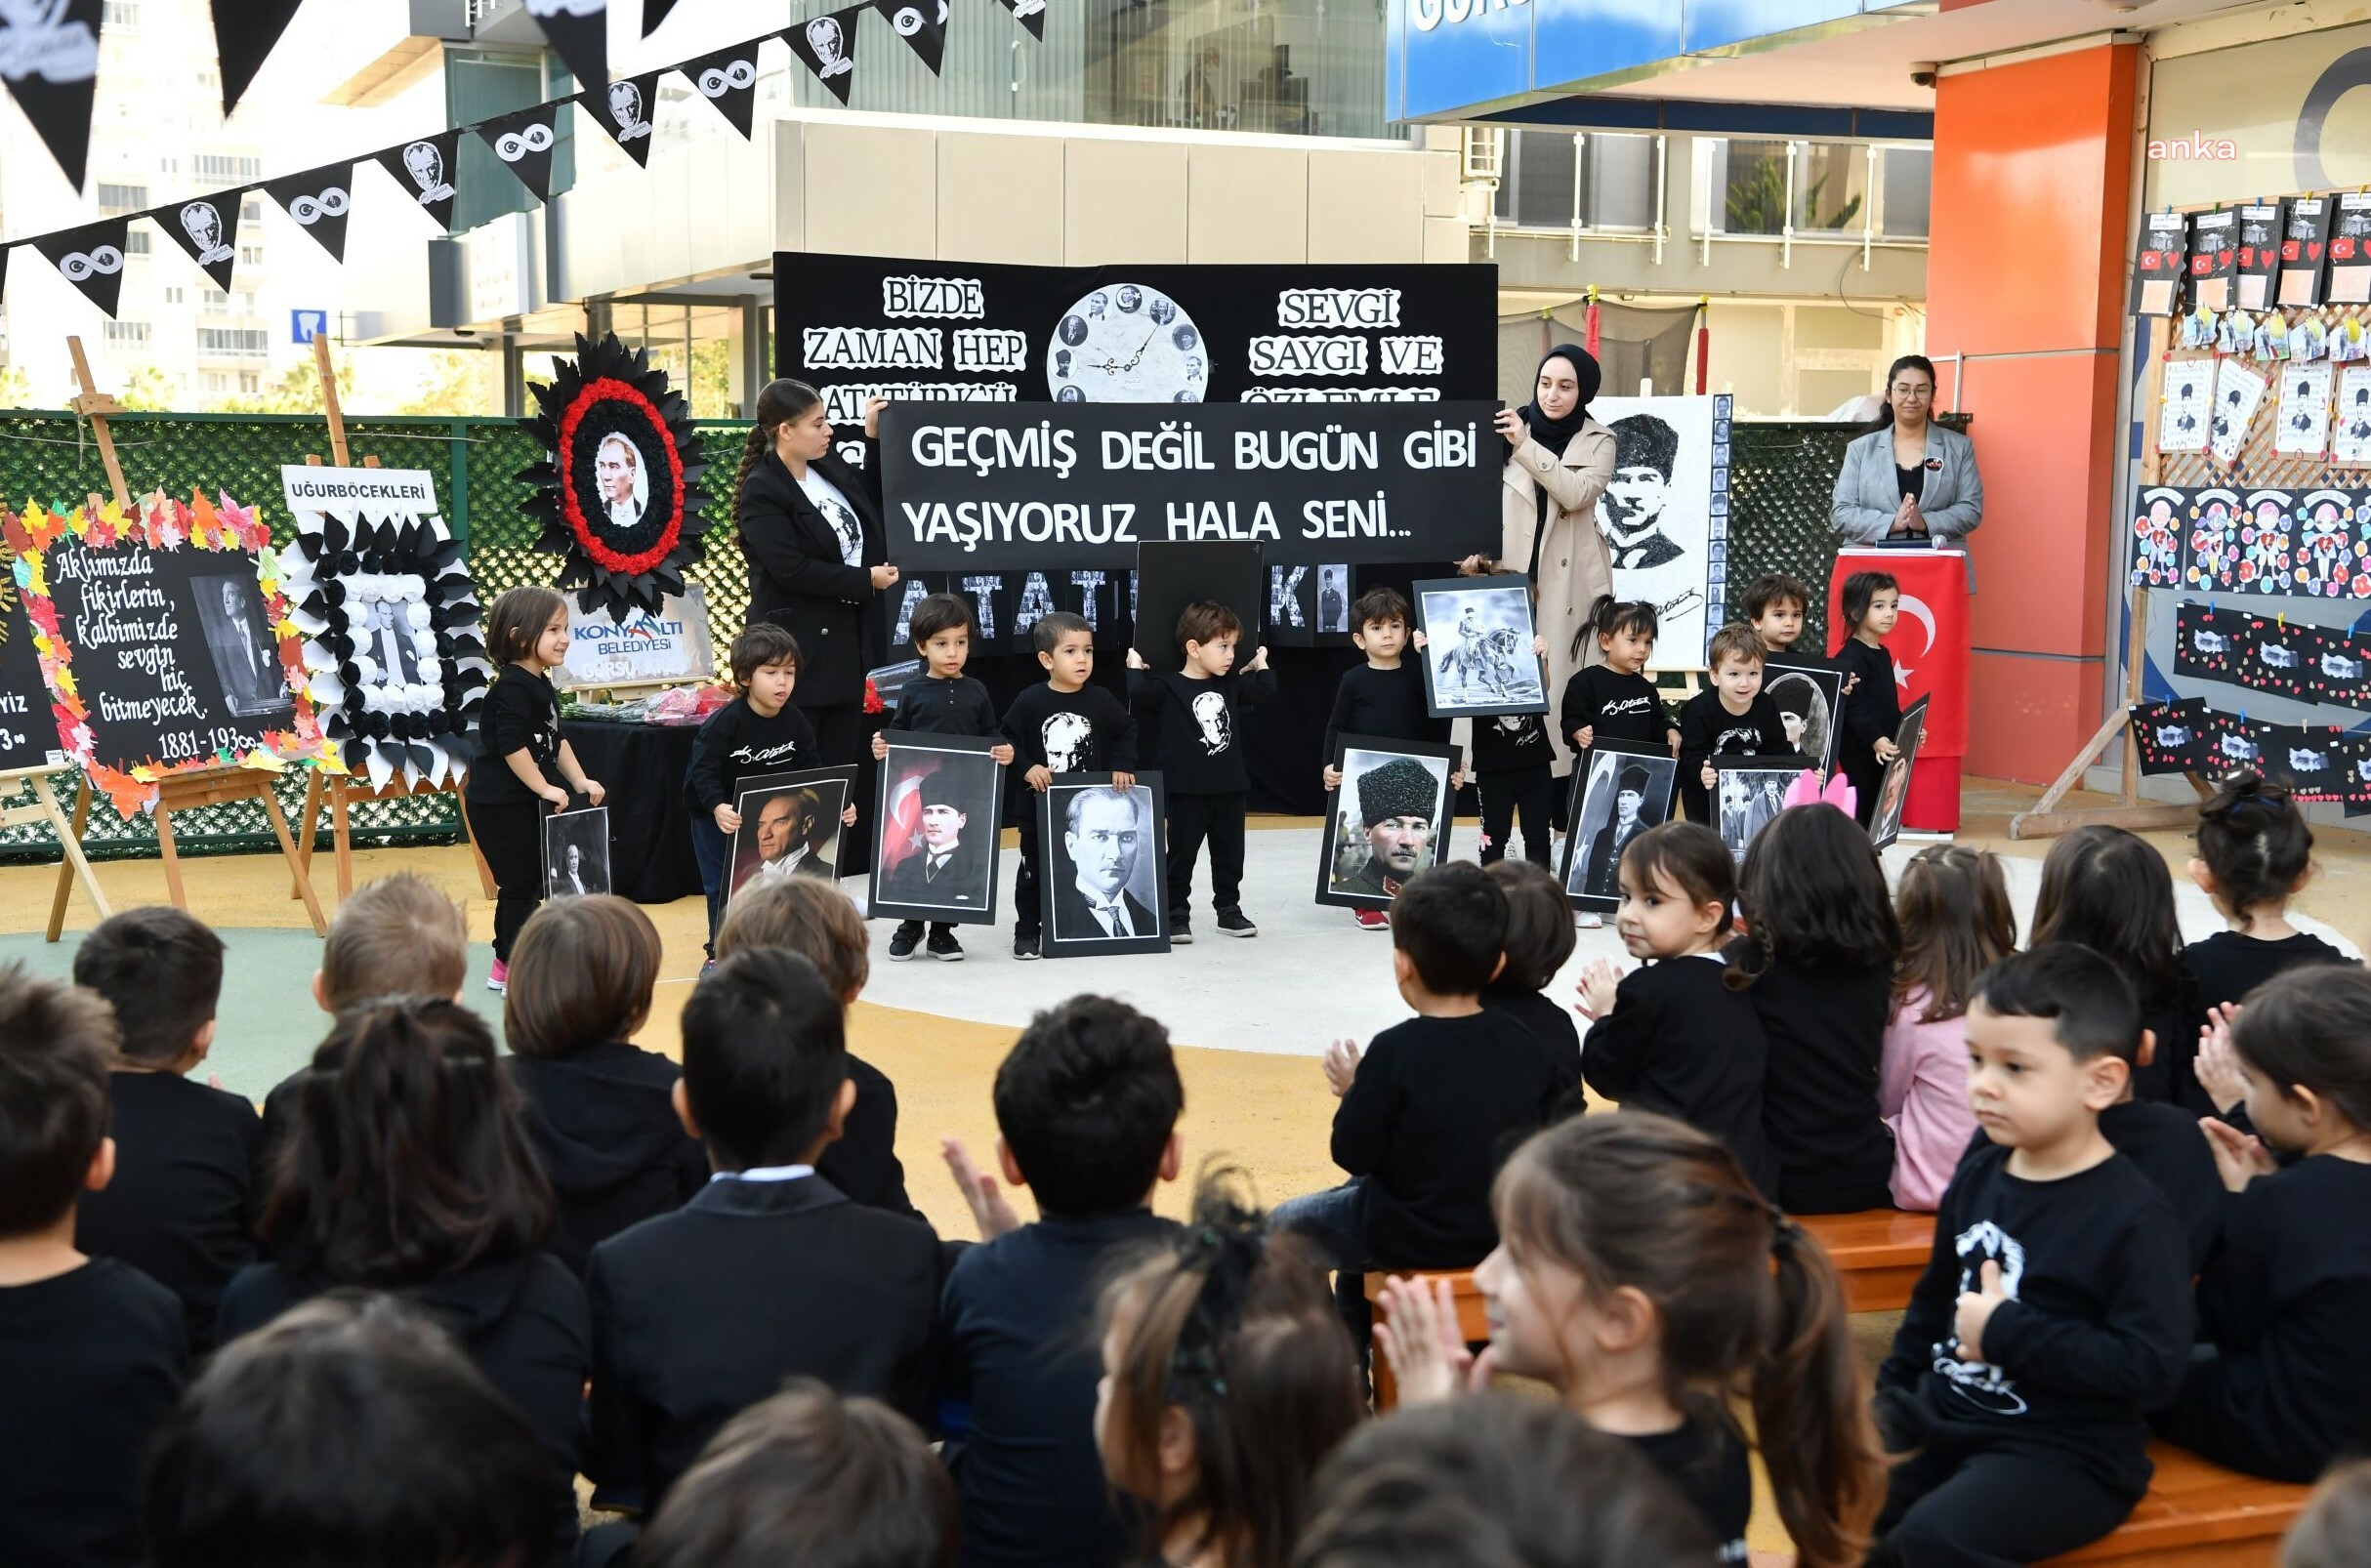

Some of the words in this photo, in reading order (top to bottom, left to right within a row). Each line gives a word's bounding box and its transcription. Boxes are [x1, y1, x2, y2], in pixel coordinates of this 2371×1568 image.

[887, 275, 982, 315] BİZDE
[1283, 289, 1394, 324] SEVGİ
[808, 331, 940, 365] ZAMAN
[957, 334, 1024, 366] HEP
[1254, 340, 1363, 371] SAYGI
[1384, 340, 1438, 371] VE
[911, 420, 1077, 478] GEÇMİŞ
[1101, 421, 1215, 471] DEĞİL
[1234, 424, 1379, 473] BUGÜN
[1402, 420, 1477, 470] GİBİ
[291, 479, 427, 500] UĞURBÖCEKLERİ
[901, 500, 1137, 553] YAŞIYORUZ
[1166, 500, 1281, 541] HALA
[1301, 490, 1412, 539] SENİ...
[75, 612, 179, 651] kalbimizde
[598, 639, 672, 656] BELEDİYESİ
[117, 644, 177, 676] sevgin
